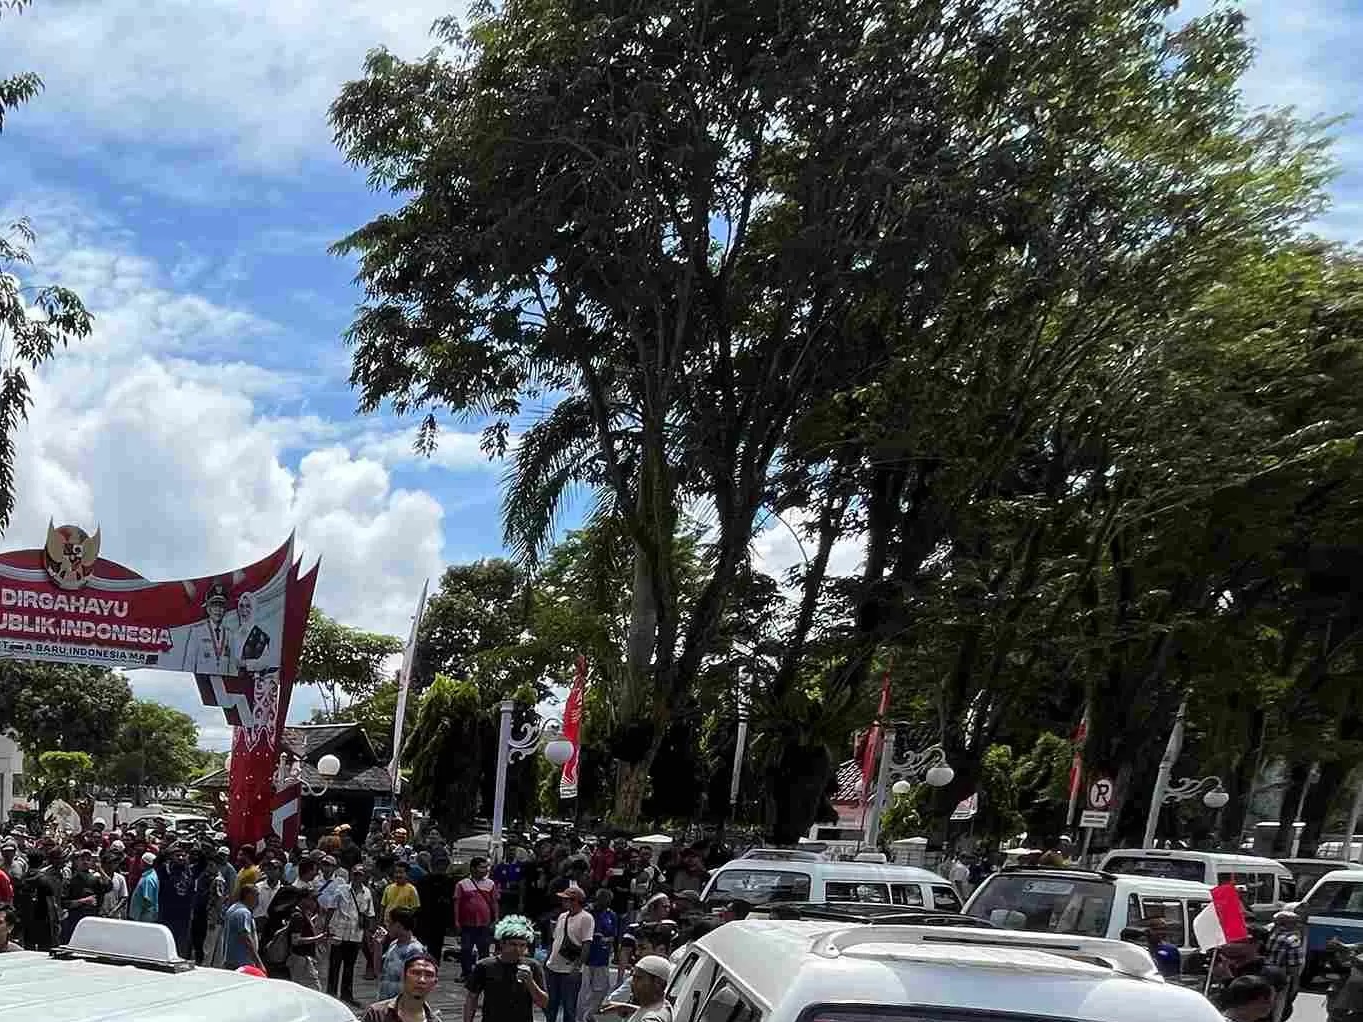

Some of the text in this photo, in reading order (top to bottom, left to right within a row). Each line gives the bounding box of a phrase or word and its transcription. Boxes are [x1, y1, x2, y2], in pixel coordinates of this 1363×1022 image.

[1, 588, 128, 618] DIRGAHAYU
[60, 620, 172, 646] INDONESIA
[69, 647, 126, 660] INDONESIA
